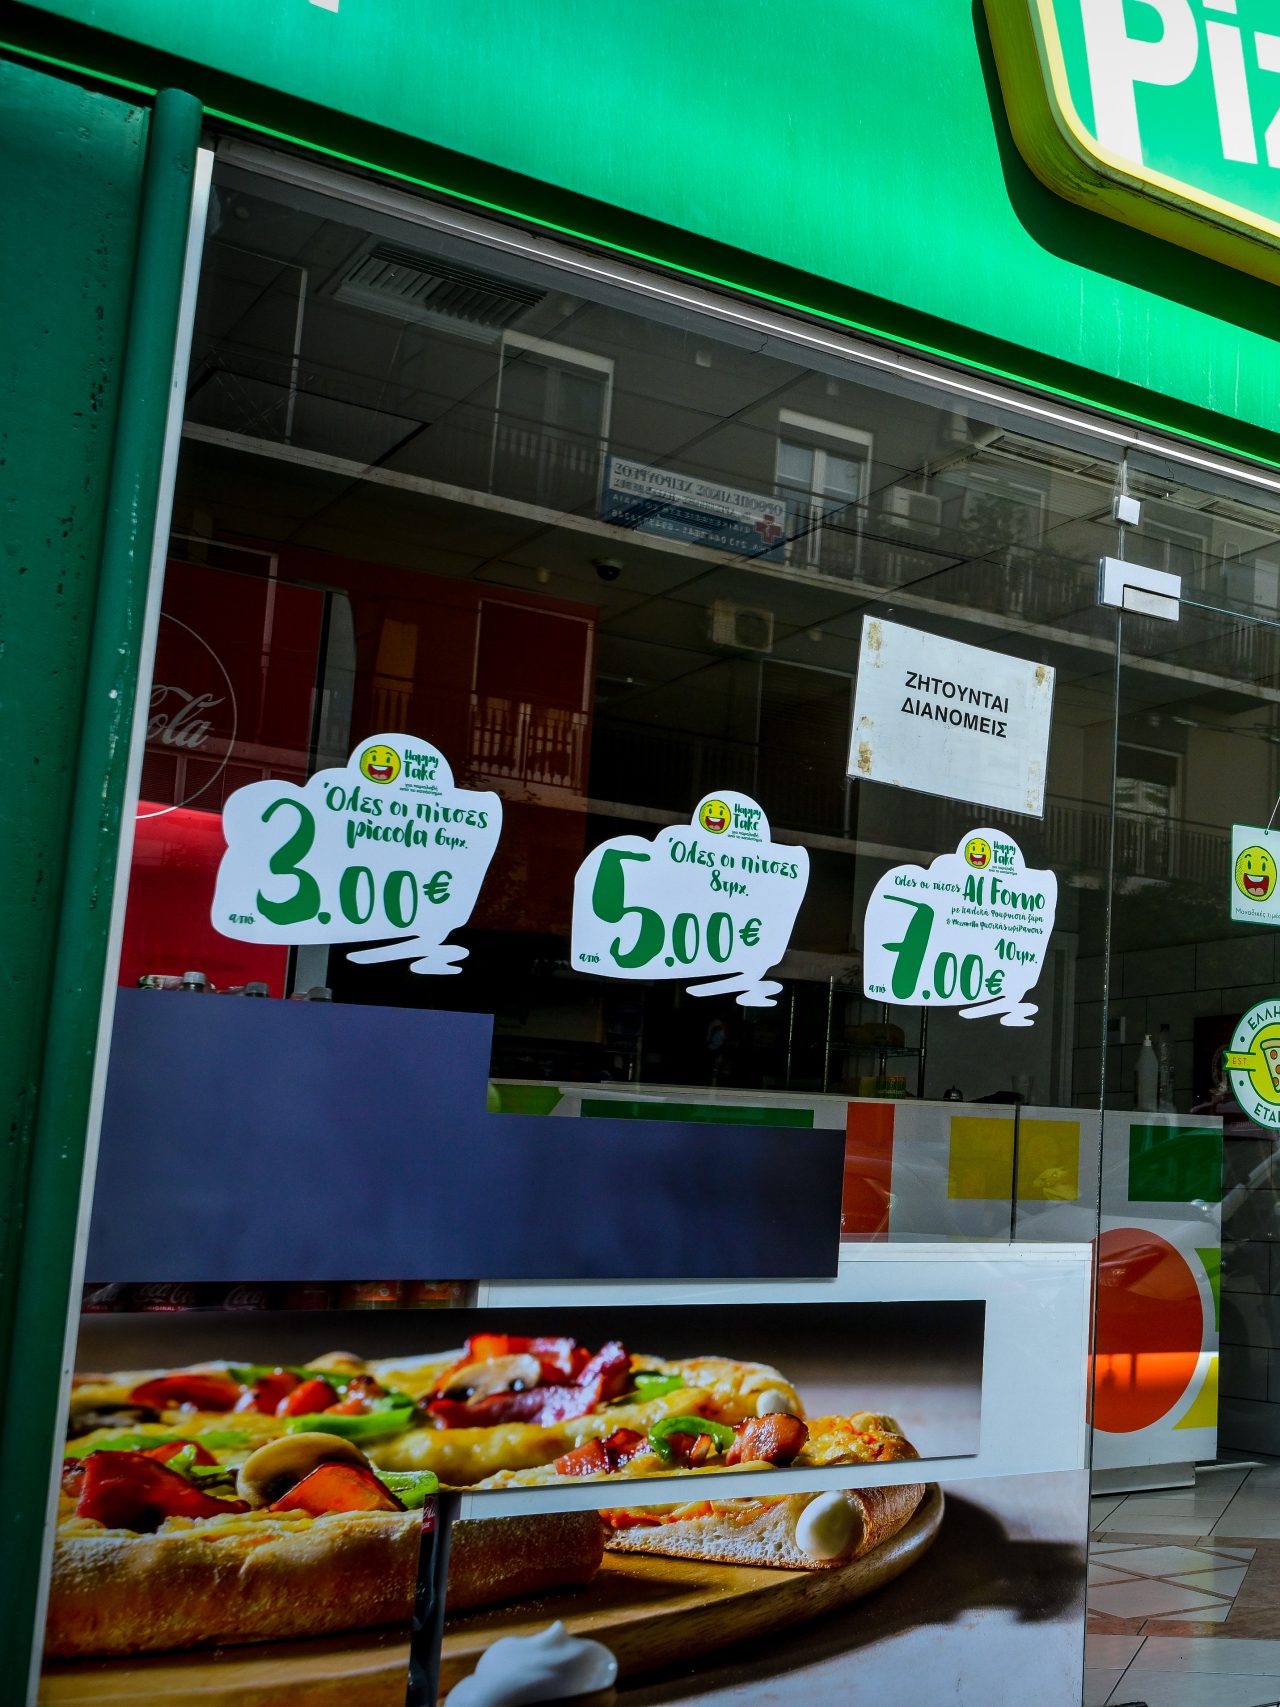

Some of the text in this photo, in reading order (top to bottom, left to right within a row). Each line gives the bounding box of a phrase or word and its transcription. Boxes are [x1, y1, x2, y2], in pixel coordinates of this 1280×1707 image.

[905, 670, 1009, 714] ΖΗΤΟΥΝΤΑΙ
[900, 697, 1008, 738] ΔΙΑΝΟΜΕΙΣ
[404, 749, 439, 768] Happy
[403, 760, 436, 781] Take
[390, 800, 408, 817] οι
[416, 802, 489, 829] πίτσες
[734, 803, 761, 820] Happy
[733, 813, 759, 831] Take
[346, 818, 428, 849] piccola
[993, 840, 1016, 856] Happy
[721, 854, 735, 868] οι
[741, 855, 799, 879] πίτσες
[992, 850, 1015, 866] Take
[962, 874, 985, 907] Al
[991, 876, 1046, 912] Forno
[228, 912, 256, 925] από
[579, 952, 601, 964] από
[868, 984, 886, 994] από
[1232, 1057, 1249, 1066] EST.
